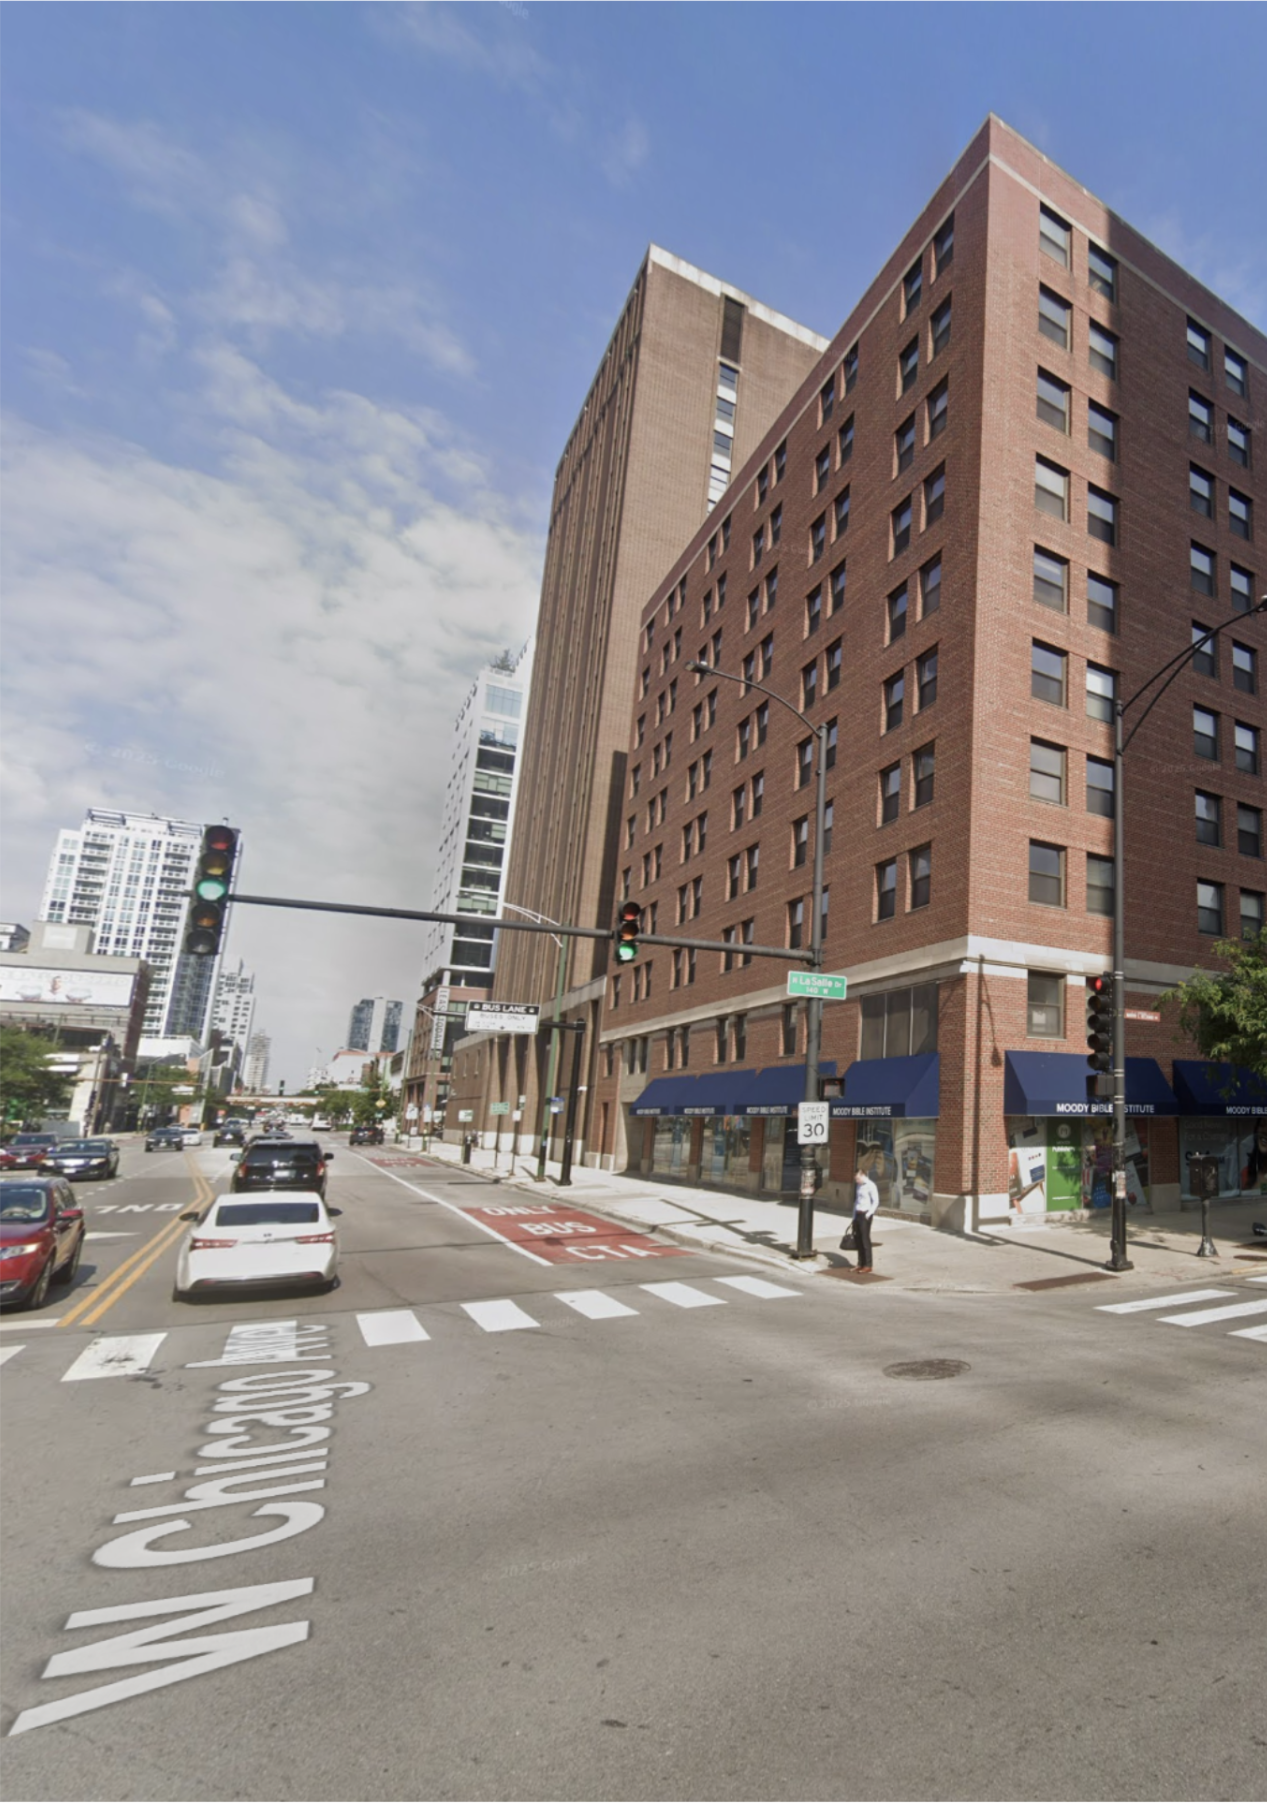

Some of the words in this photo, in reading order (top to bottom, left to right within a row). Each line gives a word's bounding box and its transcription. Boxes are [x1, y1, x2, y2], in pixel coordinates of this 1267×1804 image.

[481, 1003, 500, 1011] BUS
[502, 1005, 527, 1013] LANE
[802, 1106, 826, 1114] SPEED
[832, 1107, 851, 1116] MOODY
[852, 1107, 865, 1116] BIBLE
[866, 1106, 892, 1115] INSTITUTE
[1056, 1103, 1089, 1113] MOODY
[1091, 1104, 1113, 1113] BIBLE
[1124, 1104, 1155, 1113] STITUTE
[1226, 1106, 1251, 1115] MOODY
[1251, 1106, 1267, 1115] BIBLE
[803, 1123, 825, 1138] 30
[94, 1203, 183, 1214] ONL
[482, 1205, 555, 1216] ONLY
[519, 1221, 597, 1235] BUS
[566, 1245, 662, 1260] CTA
